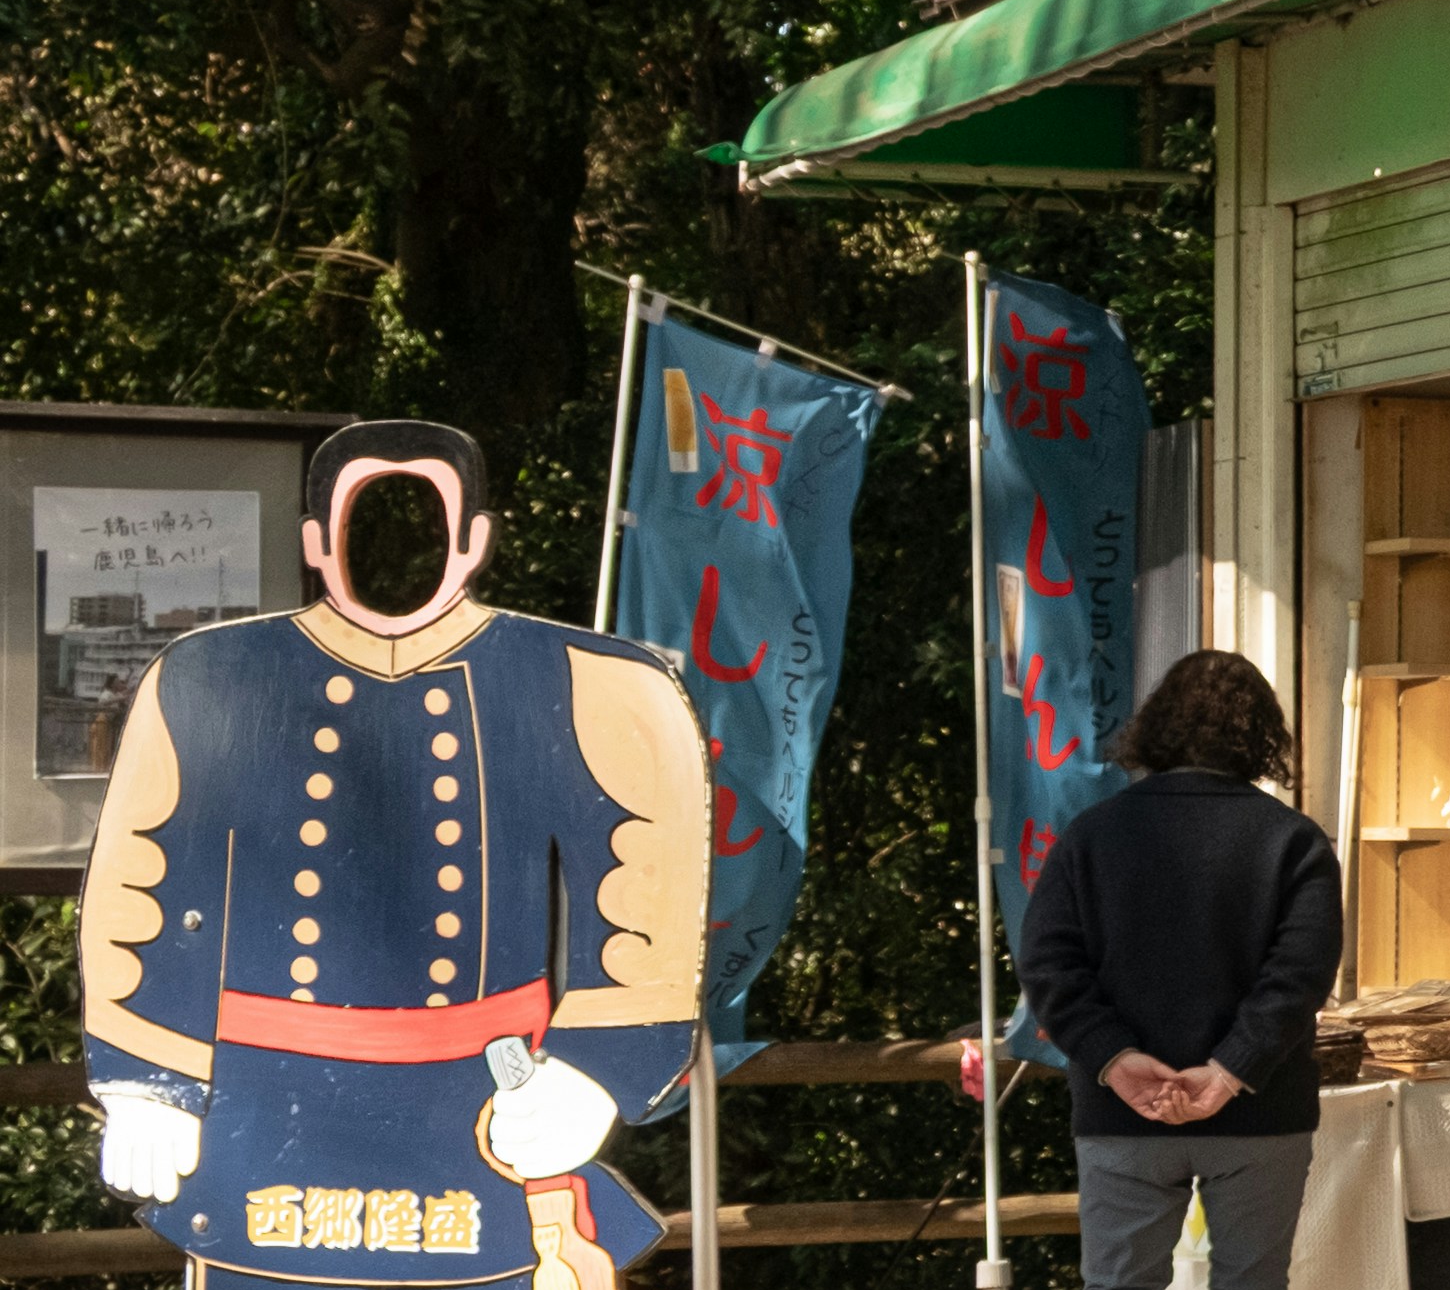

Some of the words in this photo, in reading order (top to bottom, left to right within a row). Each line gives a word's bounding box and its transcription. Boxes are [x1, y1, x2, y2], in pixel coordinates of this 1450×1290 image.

[80, 512, 213, 536] 一緒に帰ろう
[244, 1183, 483, 1257] 西郷隆盛
